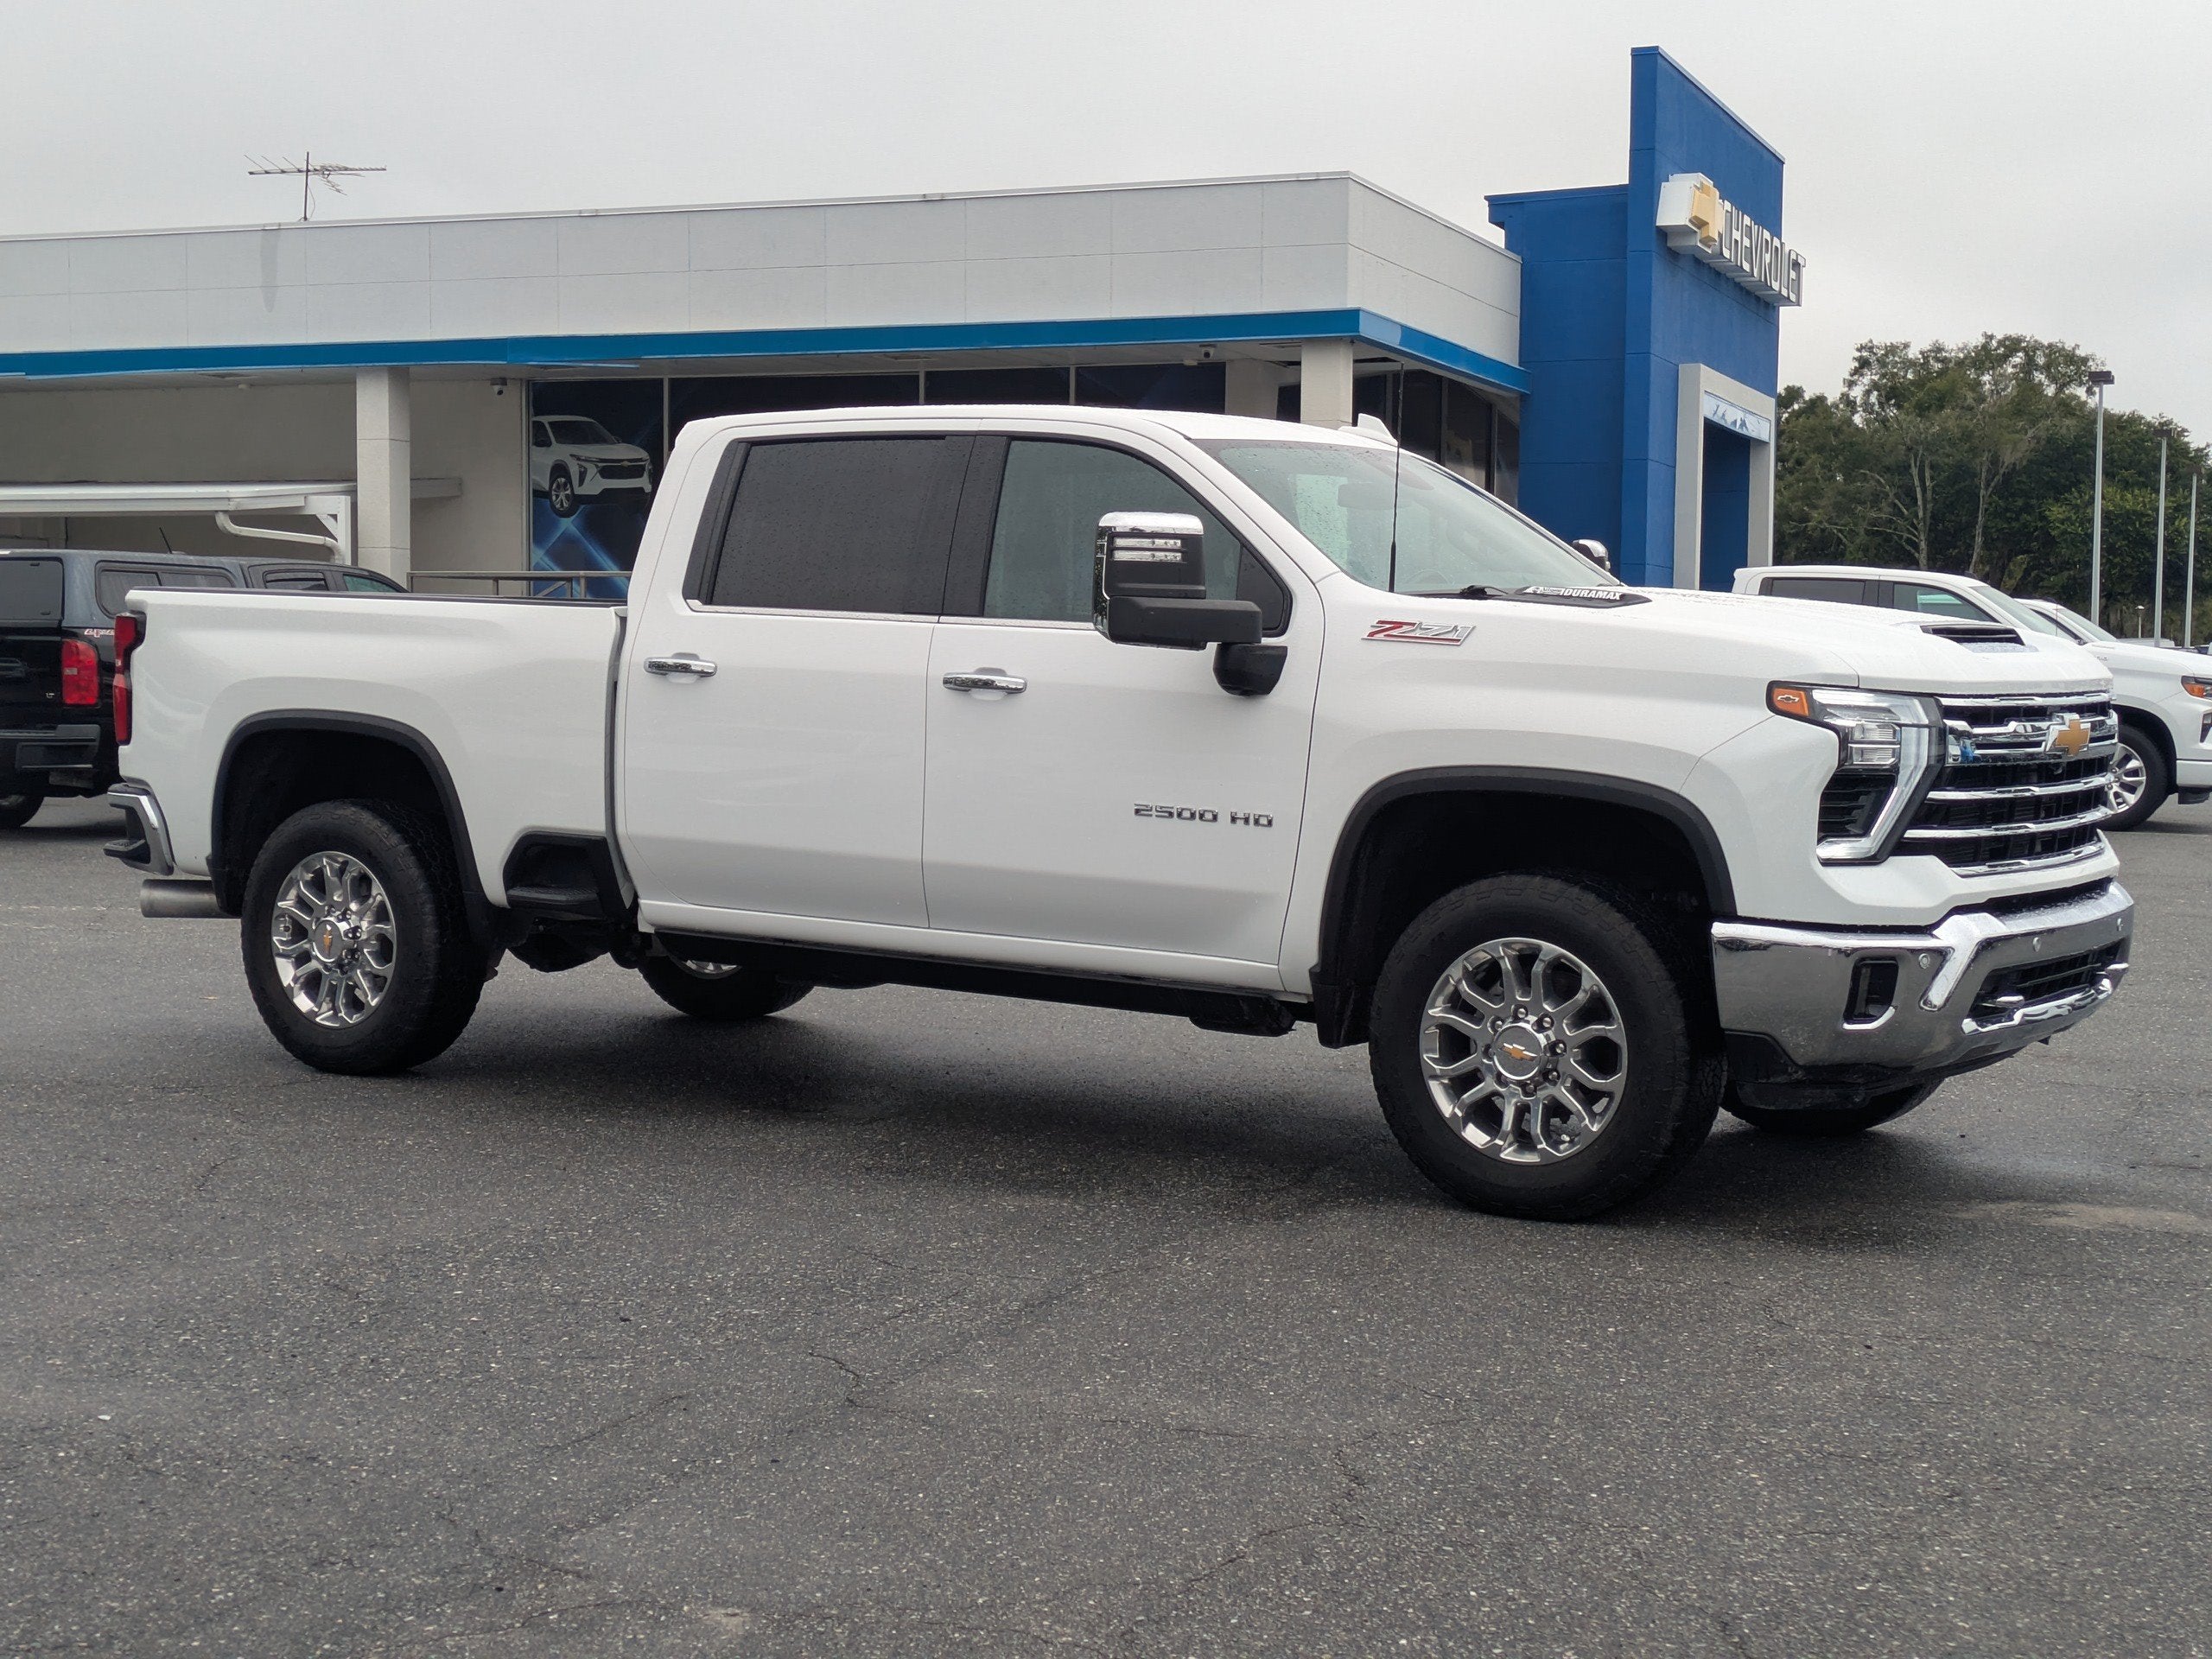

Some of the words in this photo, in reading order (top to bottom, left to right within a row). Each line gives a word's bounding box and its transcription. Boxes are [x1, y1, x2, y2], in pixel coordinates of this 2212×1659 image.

[1723, 200, 1806, 306] CHEVROLET
[1563, 588, 1623, 601] DURAMAX
[1363, 619, 1476, 645] Z71
[1134, 804, 1218, 823] 2500
[1230, 810, 1273, 828] HD
